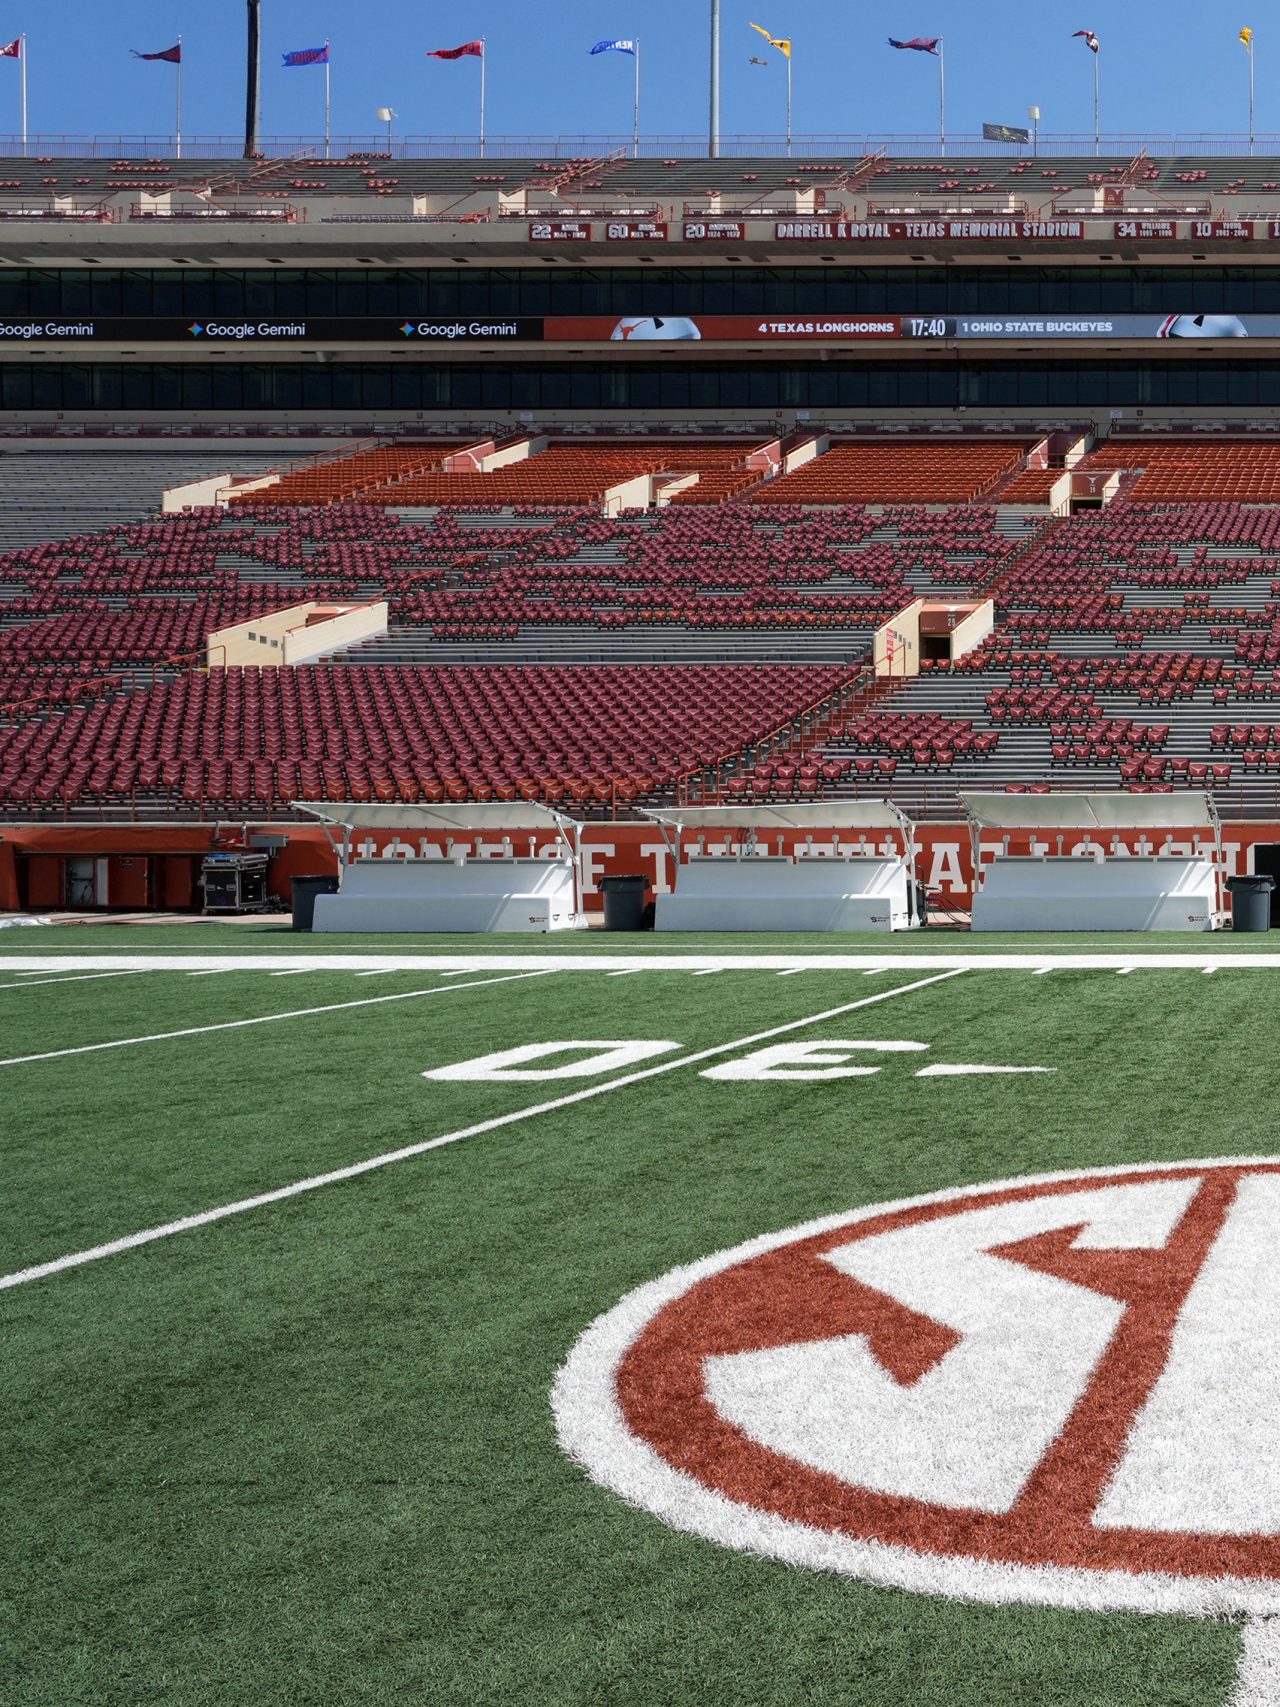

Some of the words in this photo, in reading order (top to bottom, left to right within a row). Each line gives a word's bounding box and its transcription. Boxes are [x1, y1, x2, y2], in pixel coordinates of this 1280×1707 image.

[532, 224, 551, 239] 22
[608, 224, 628, 239] 60
[686, 224, 705, 238] 20
[777, 223, 832, 238] DARRELL
[837, 223, 847, 238] K
[851, 223, 890, 238] ROYAL
[905, 223, 945, 237] TEXAS
[950, 223, 1018, 237] MEMORIAL
[1023, 223, 1081, 237] STADIUM
[1118, 222, 1136, 237] 34
[1196, 222, 1212, 237] 10
[45, 322, 94, 336] Gemini
[206, 323, 255, 339] Google
[258, 323, 306, 336] Gemini
[418, 322, 467, 338] Google
[468, 322, 517, 336] Gemini
[758, 323, 768, 333] 4
[770, 323, 814, 333] TEXAS
[816, 322, 894, 333] LONGHORNS
[911, 320, 946, 336] 17:40
[962, 322, 968, 332] 1
[971, 322, 1002, 332] OHIO
[1005, 322, 1044, 332] STATE
[1046, 322, 1112, 332] BUCKEYES
